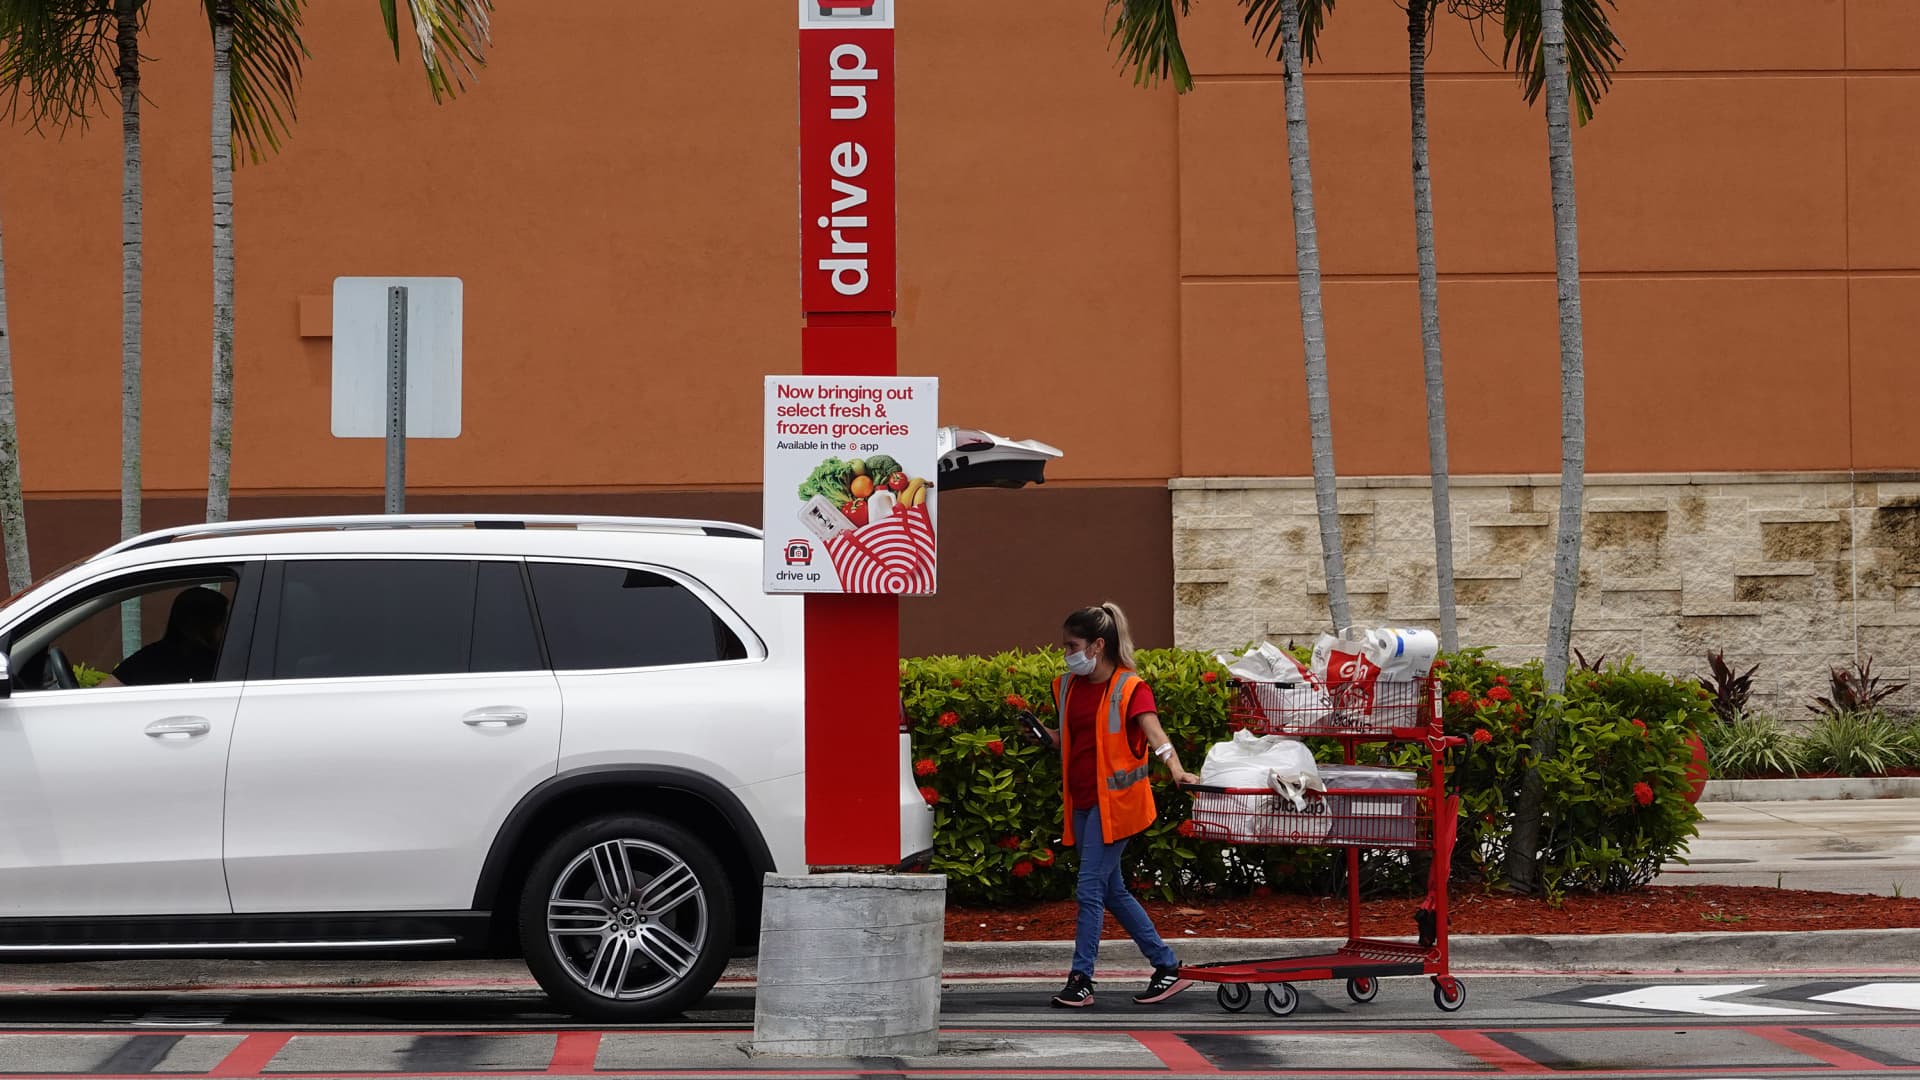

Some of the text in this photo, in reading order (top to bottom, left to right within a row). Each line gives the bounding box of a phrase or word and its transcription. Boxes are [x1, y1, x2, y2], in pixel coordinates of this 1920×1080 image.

[818, 43, 878, 296] drive up
[777, 384, 913, 403] Now bringing out
[777, 403, 887, 418] select fresh &
[776, 420, 909, 438] frozen groceries
[776, 441, 879, 452] Available in the app
[776, 570, 821, 583] drive up
